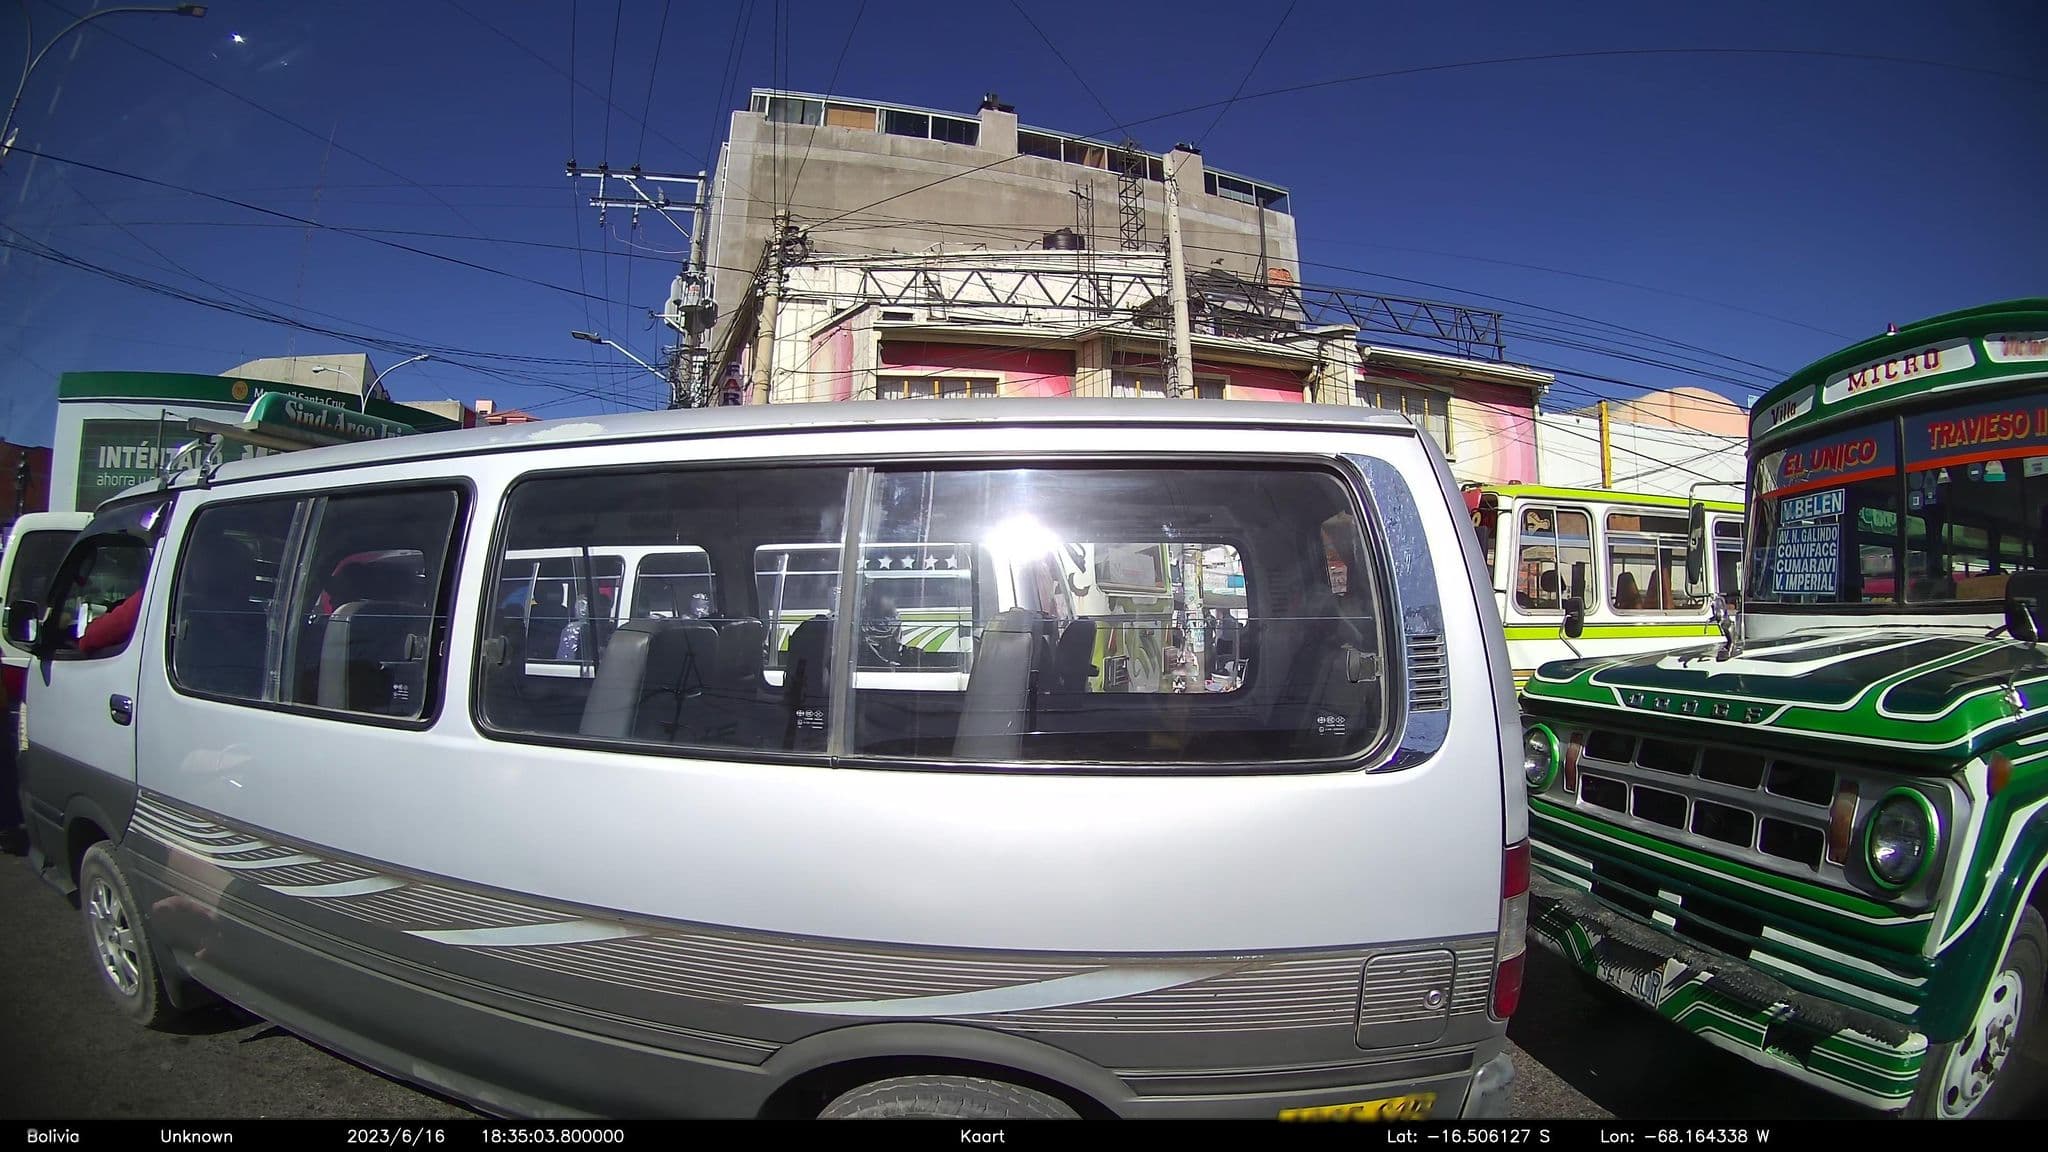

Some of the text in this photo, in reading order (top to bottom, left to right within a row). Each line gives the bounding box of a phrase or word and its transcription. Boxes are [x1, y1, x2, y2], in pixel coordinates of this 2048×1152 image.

[1848, 349, 1942, 391] MICRO
[1928, 411, 2033, 449] TRAVIESO
[1784, 440, 1878, 477] EL UNICO
[97, 471, 136, 487] ahorra
[1801, 526, 1838, 541] GALINDO
[1776, 557, 1836, 573] CUMARAVI
[1785, 572, 1834, 591] IMPERIAL
